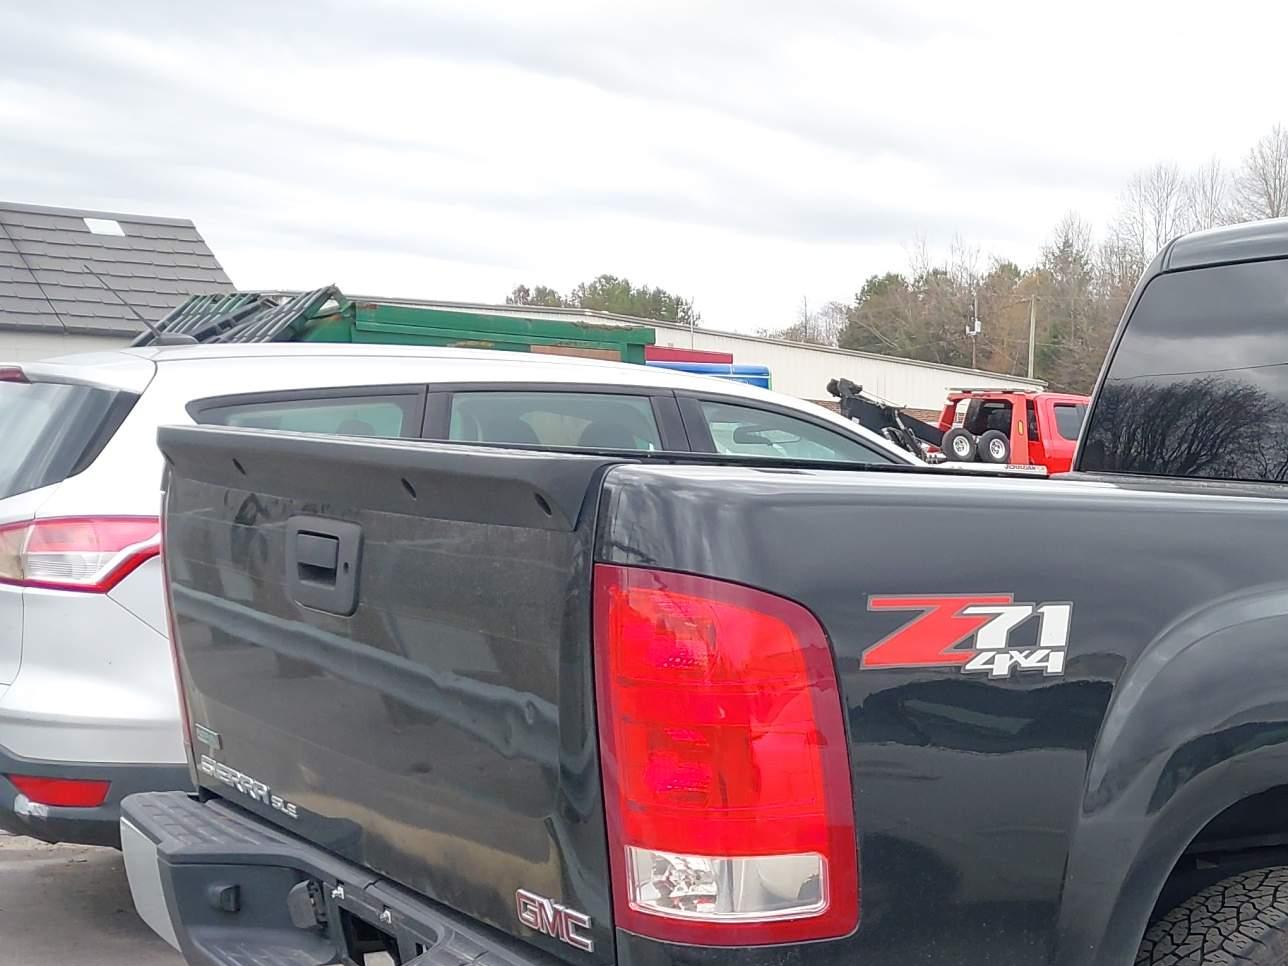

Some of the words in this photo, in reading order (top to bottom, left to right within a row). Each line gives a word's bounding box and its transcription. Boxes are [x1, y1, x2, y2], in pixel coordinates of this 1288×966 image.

[860, 592, 1073, 670] Z71
[200, 753, 270, 806] SIERRA
[515, 888, 594, 953] GMC
